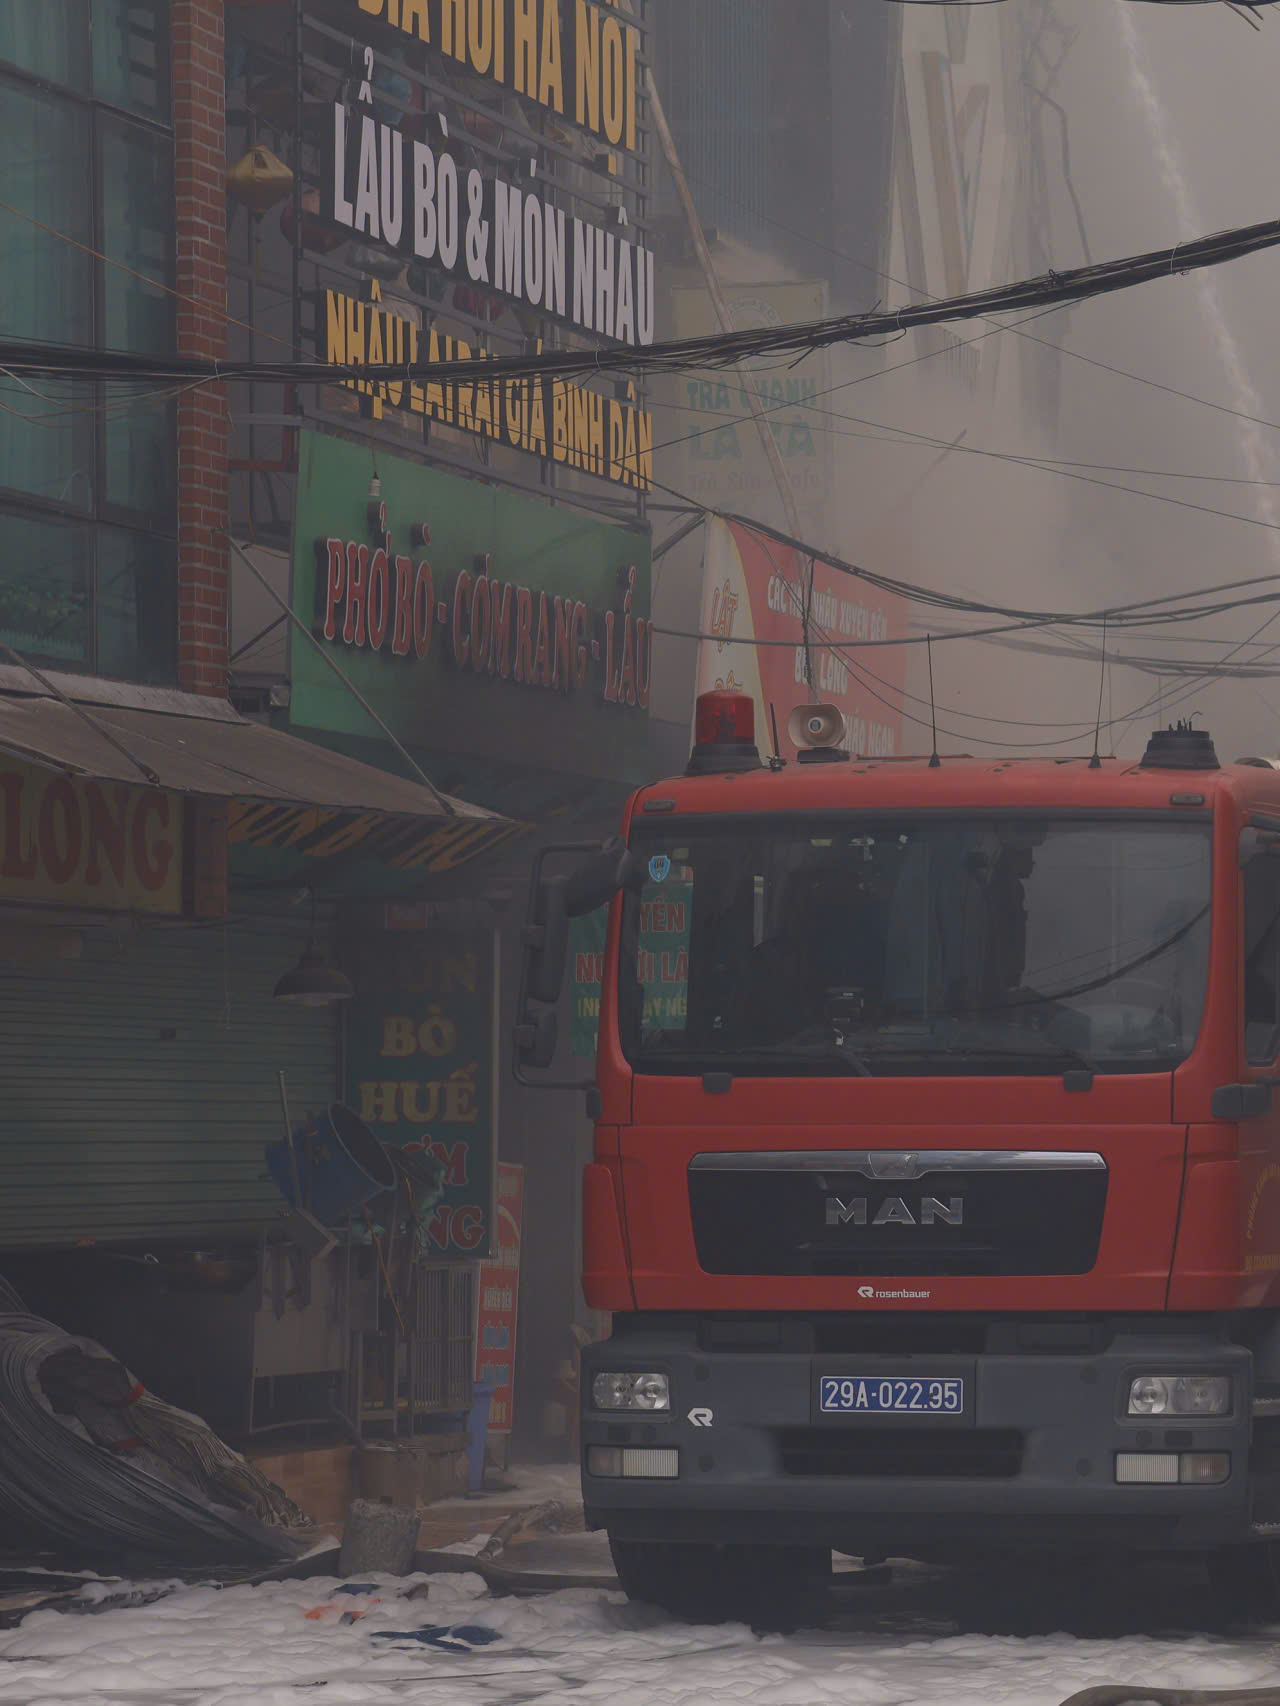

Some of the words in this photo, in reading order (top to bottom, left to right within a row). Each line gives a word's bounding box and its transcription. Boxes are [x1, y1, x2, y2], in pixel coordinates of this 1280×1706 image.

[333, 46, 402, 247] LẨU
[413, 112, 458, 270] BÒ
[465, 168, 490, 284] &
[609, 380, 653, 492] DÂN
[323, 500, 391, 650] PHỞ
[392, 522, 436, 662] BÒ
[514, 586, 591, 694] RANG
[0, 770, 174, 891] LONG
[380, 1003, 456, 1058] BÒ
[359, 1060, 479, 1124] HUẾ
[825, 1197, 964, 1225] MAN
[875, 1288, 931, 1299] rosenbauer
[824, 1380, 958, 1410] 29A-022.95
